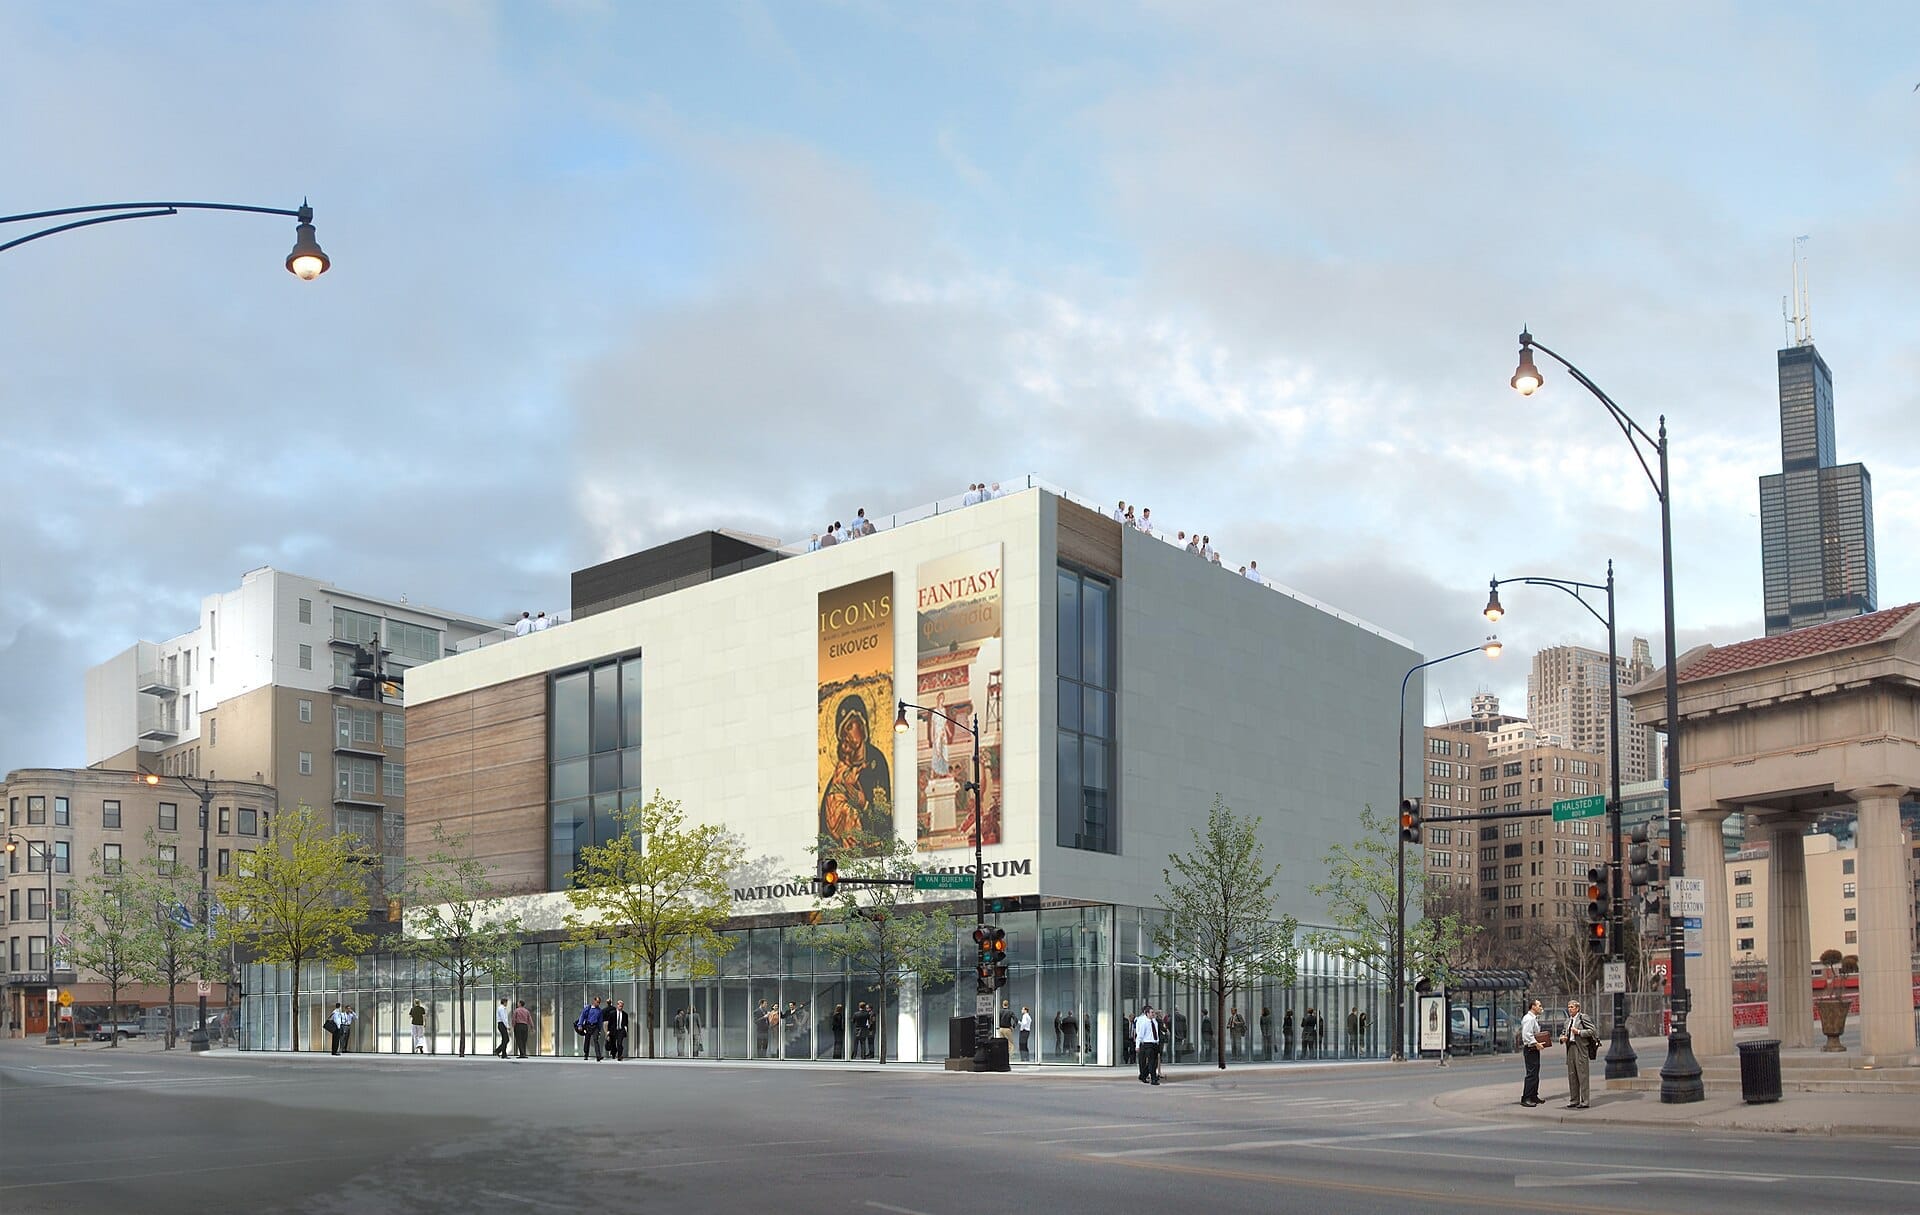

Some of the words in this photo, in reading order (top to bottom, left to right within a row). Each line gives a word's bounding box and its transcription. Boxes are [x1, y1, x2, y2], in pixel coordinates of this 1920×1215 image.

[918, 568, 999, 608] FANTASY
[820, 595, 890, 632] ICONS
[1561, 800, 1592, 811] HALSTED
[1675, 881, 1700, 891] WELCOME
[1673, 902, 1704, 912] GREEKTOWN
